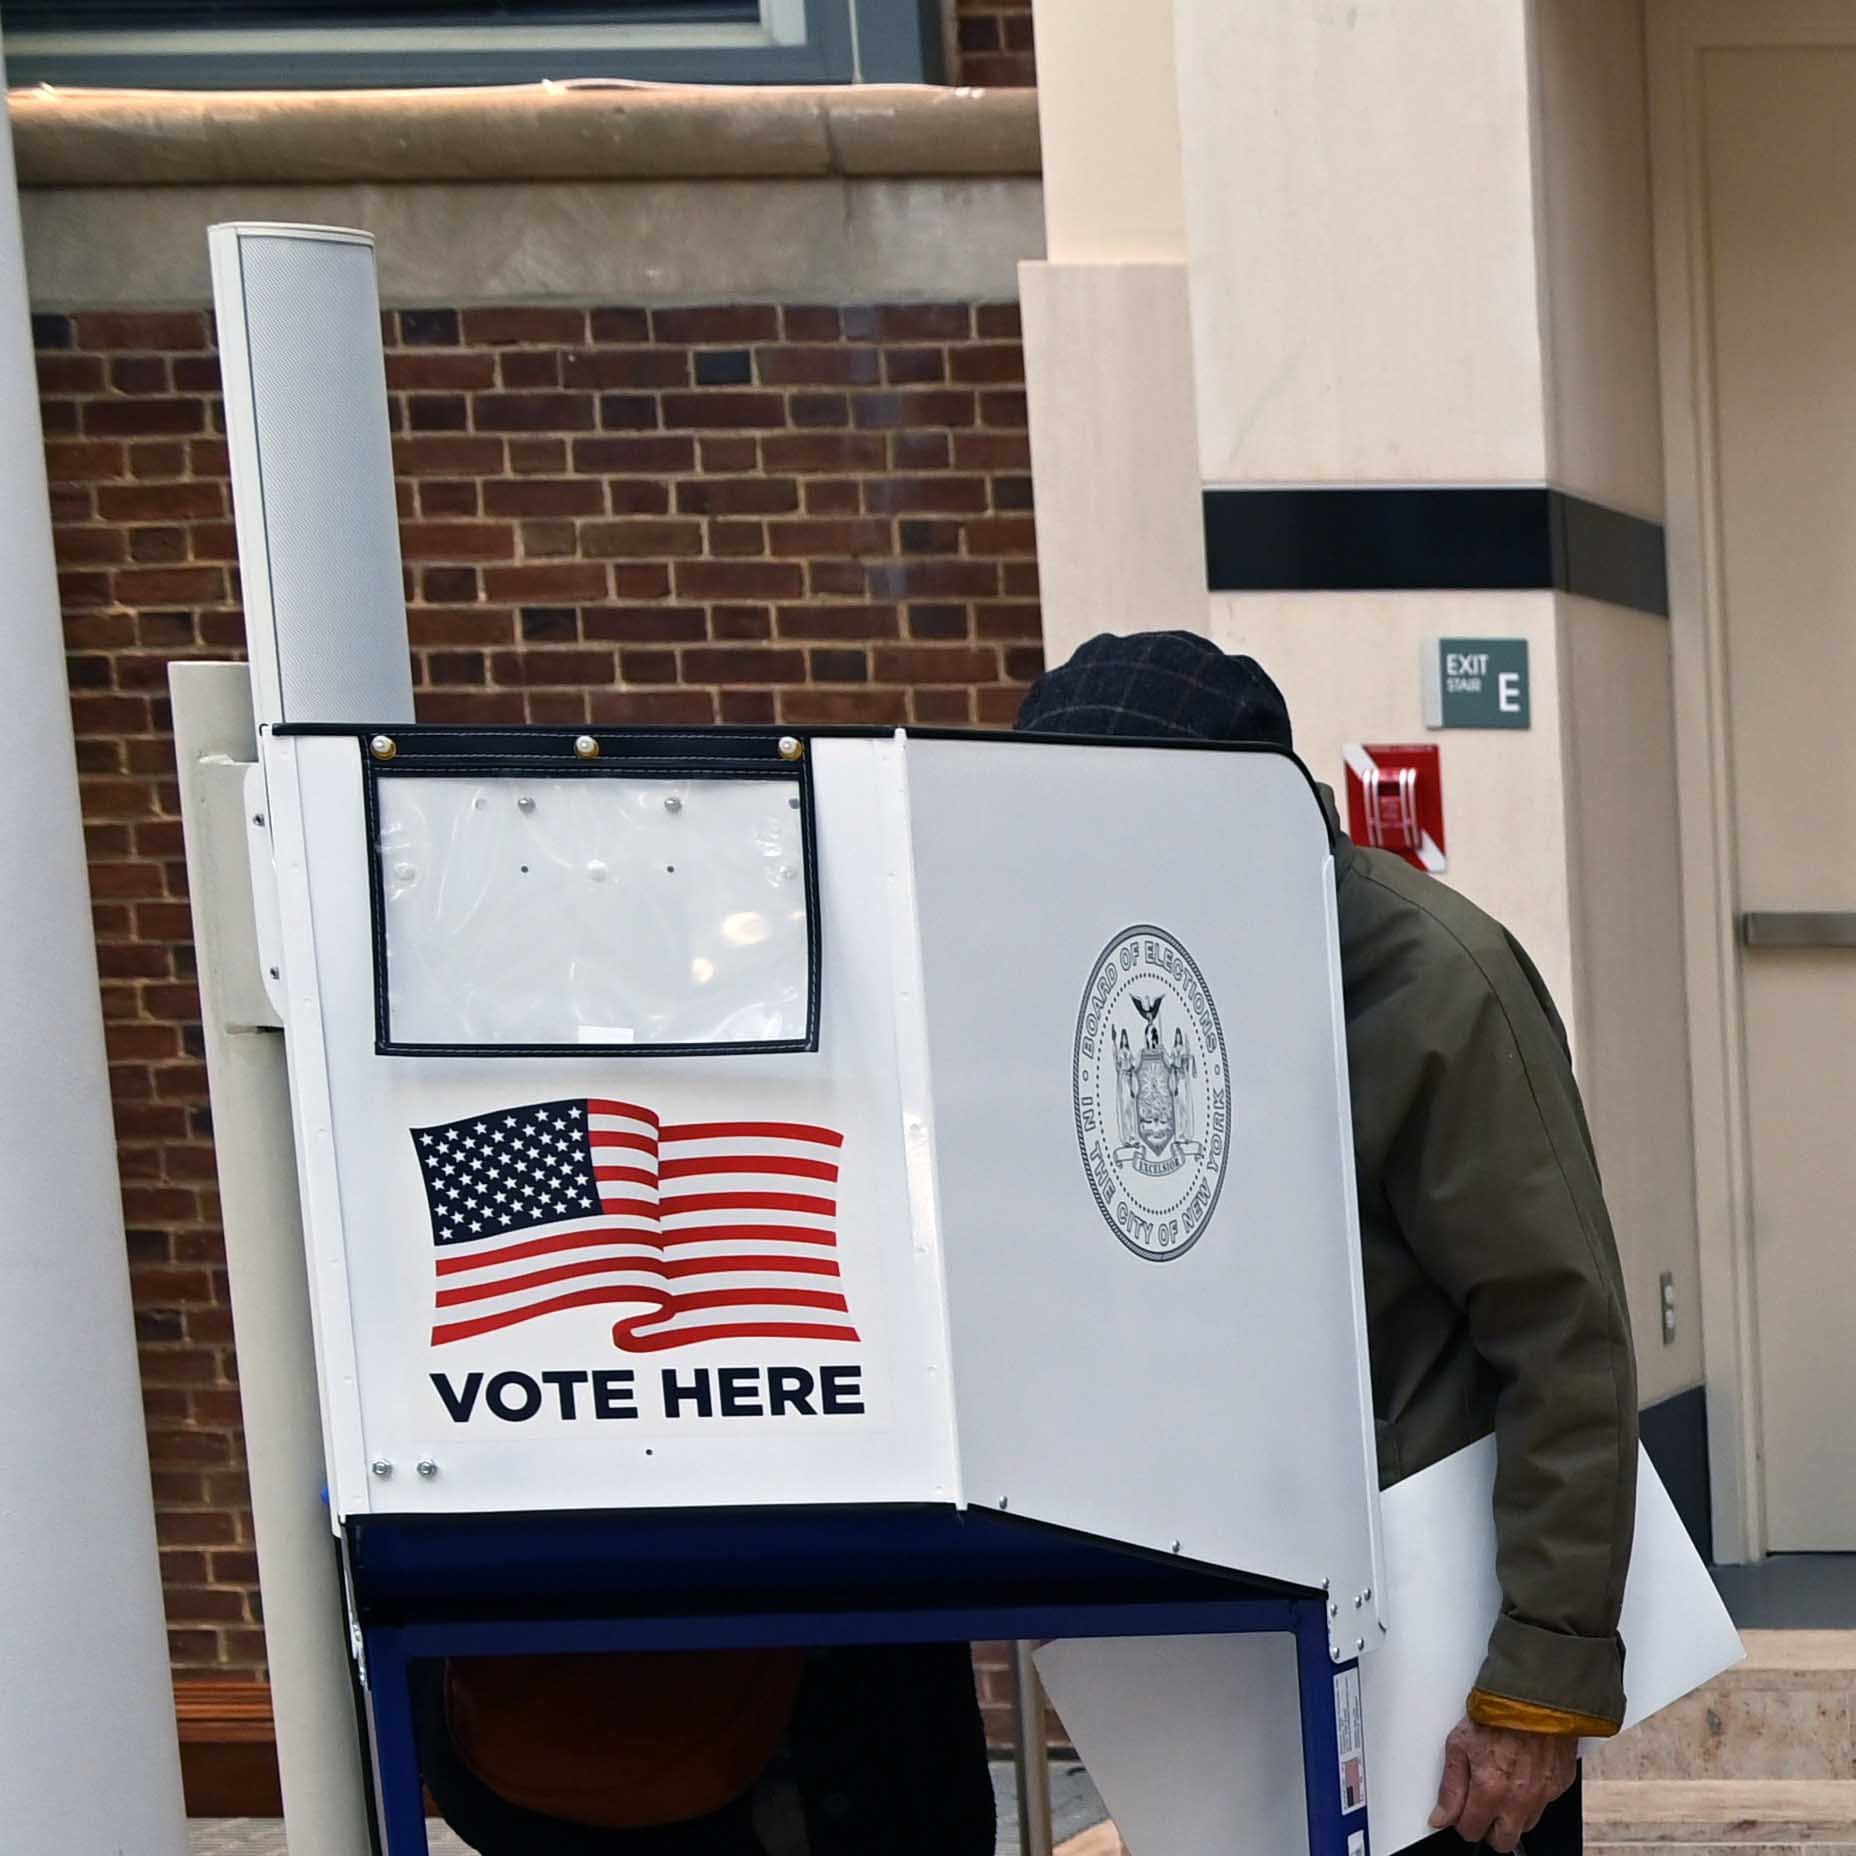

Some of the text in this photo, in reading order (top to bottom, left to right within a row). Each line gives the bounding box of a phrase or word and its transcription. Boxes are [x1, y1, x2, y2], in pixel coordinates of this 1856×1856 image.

[1446, 653, 1489, 676] EXIT
[1446, 677, 1482, 693] STAIR
[1498, 672, 1521, 712] E
[1082, 940, 1217, 1059] BOARD OF ELECTIONS
[1081, 1087, 1225, 1246] IN THE CITY OF NEW YORK
[429, 1365, 865, 1422] VOTE HERE
